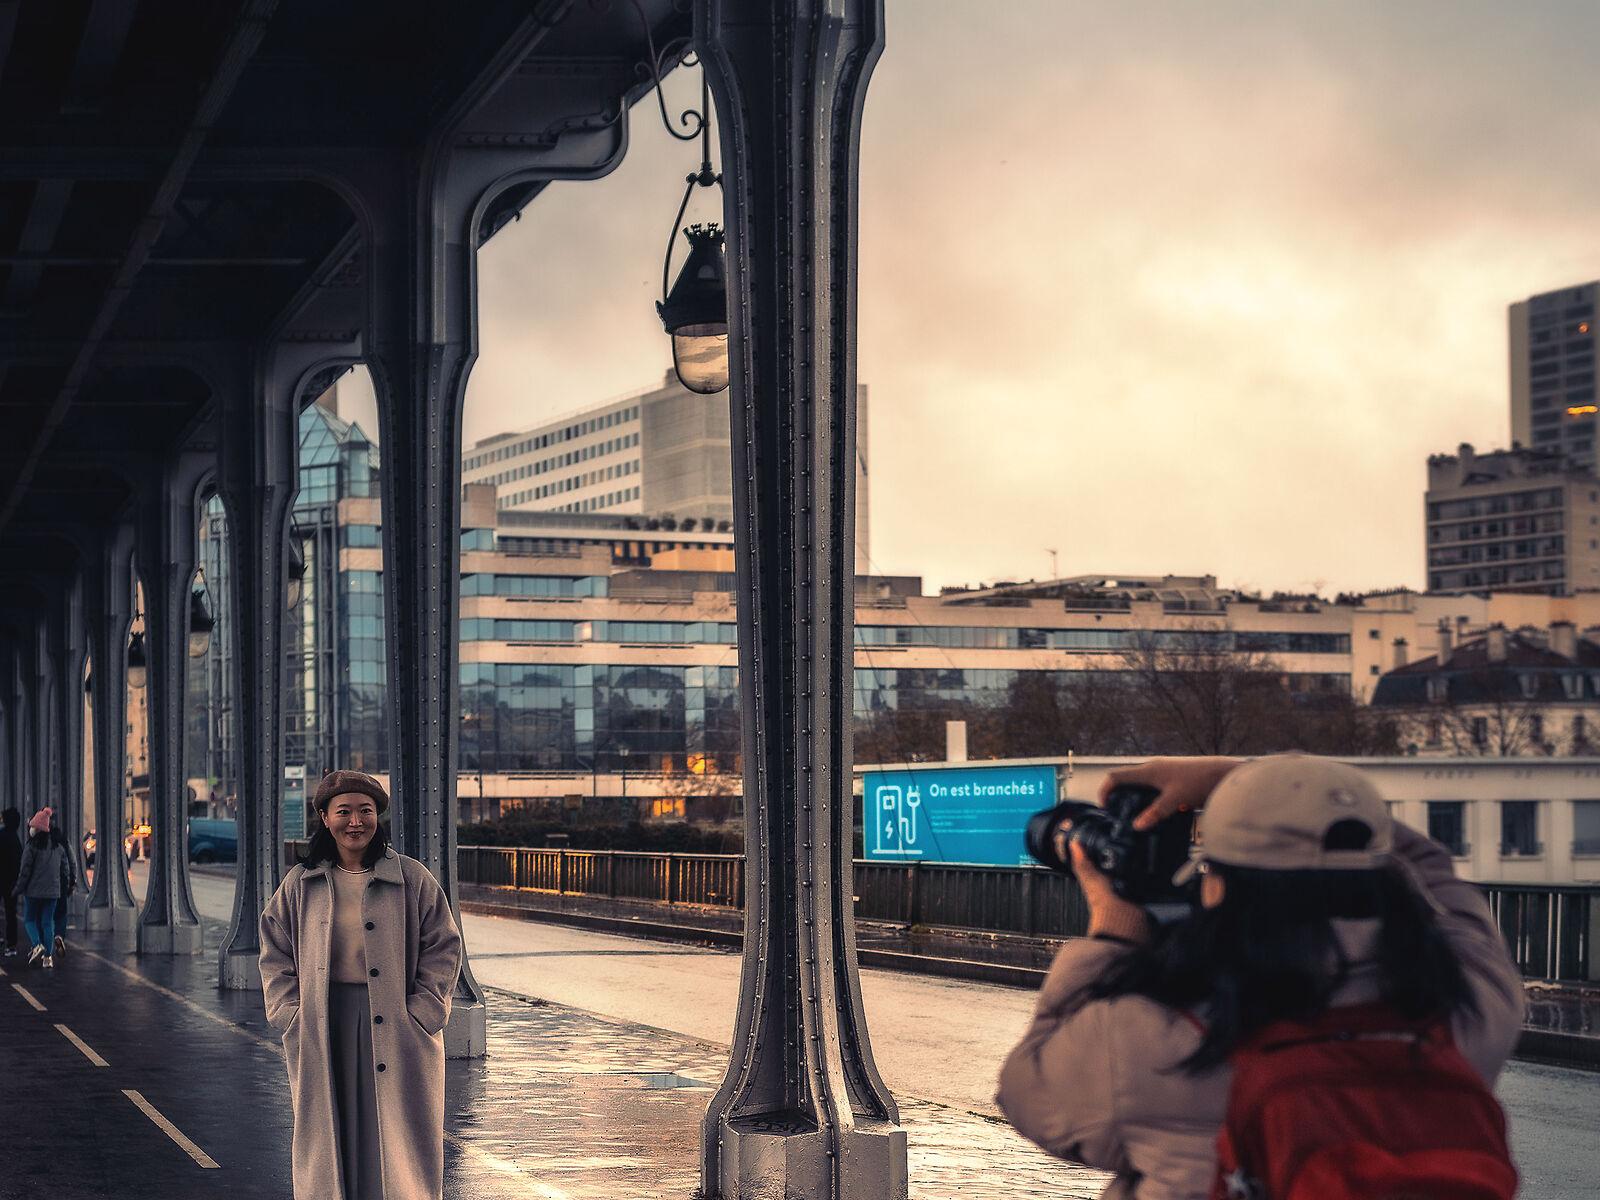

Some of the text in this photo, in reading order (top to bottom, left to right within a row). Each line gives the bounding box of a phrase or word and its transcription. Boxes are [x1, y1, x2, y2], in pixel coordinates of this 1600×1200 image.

[930, 780, 1043, 797] On est branchés !
